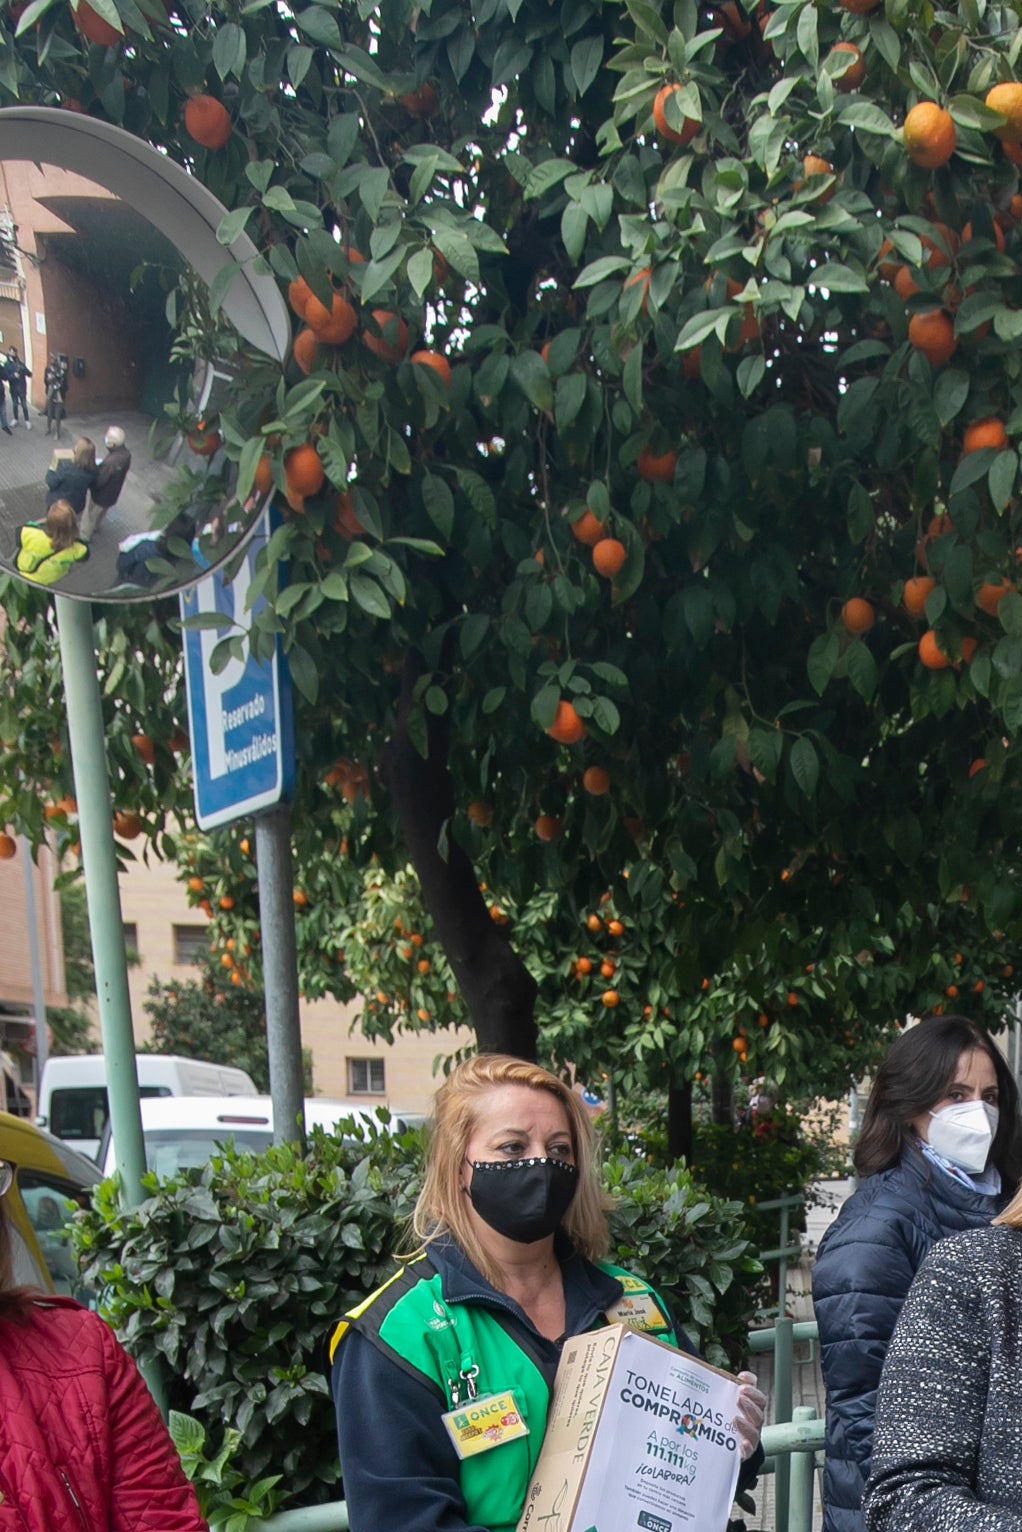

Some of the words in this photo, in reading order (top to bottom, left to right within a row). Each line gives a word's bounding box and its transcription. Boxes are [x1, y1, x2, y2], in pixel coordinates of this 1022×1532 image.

[222, 693, 265, 732] Reservado
[224, 733, 278, 771] Minusválidos
[590, 1336, 616, 1389] CAJA
[470, 1400, 507, 1420] ONCE
[620, 1388, 736, 1452] COMPROMISO
[626, 1370, 724, 1426] TONELADAS
[572, 1393, 602, 1465] VERDE
[648, 1430, 658, 1442] A
[660, 1436, 680, 1452] por
[682, 1444, 698, 1460] los
